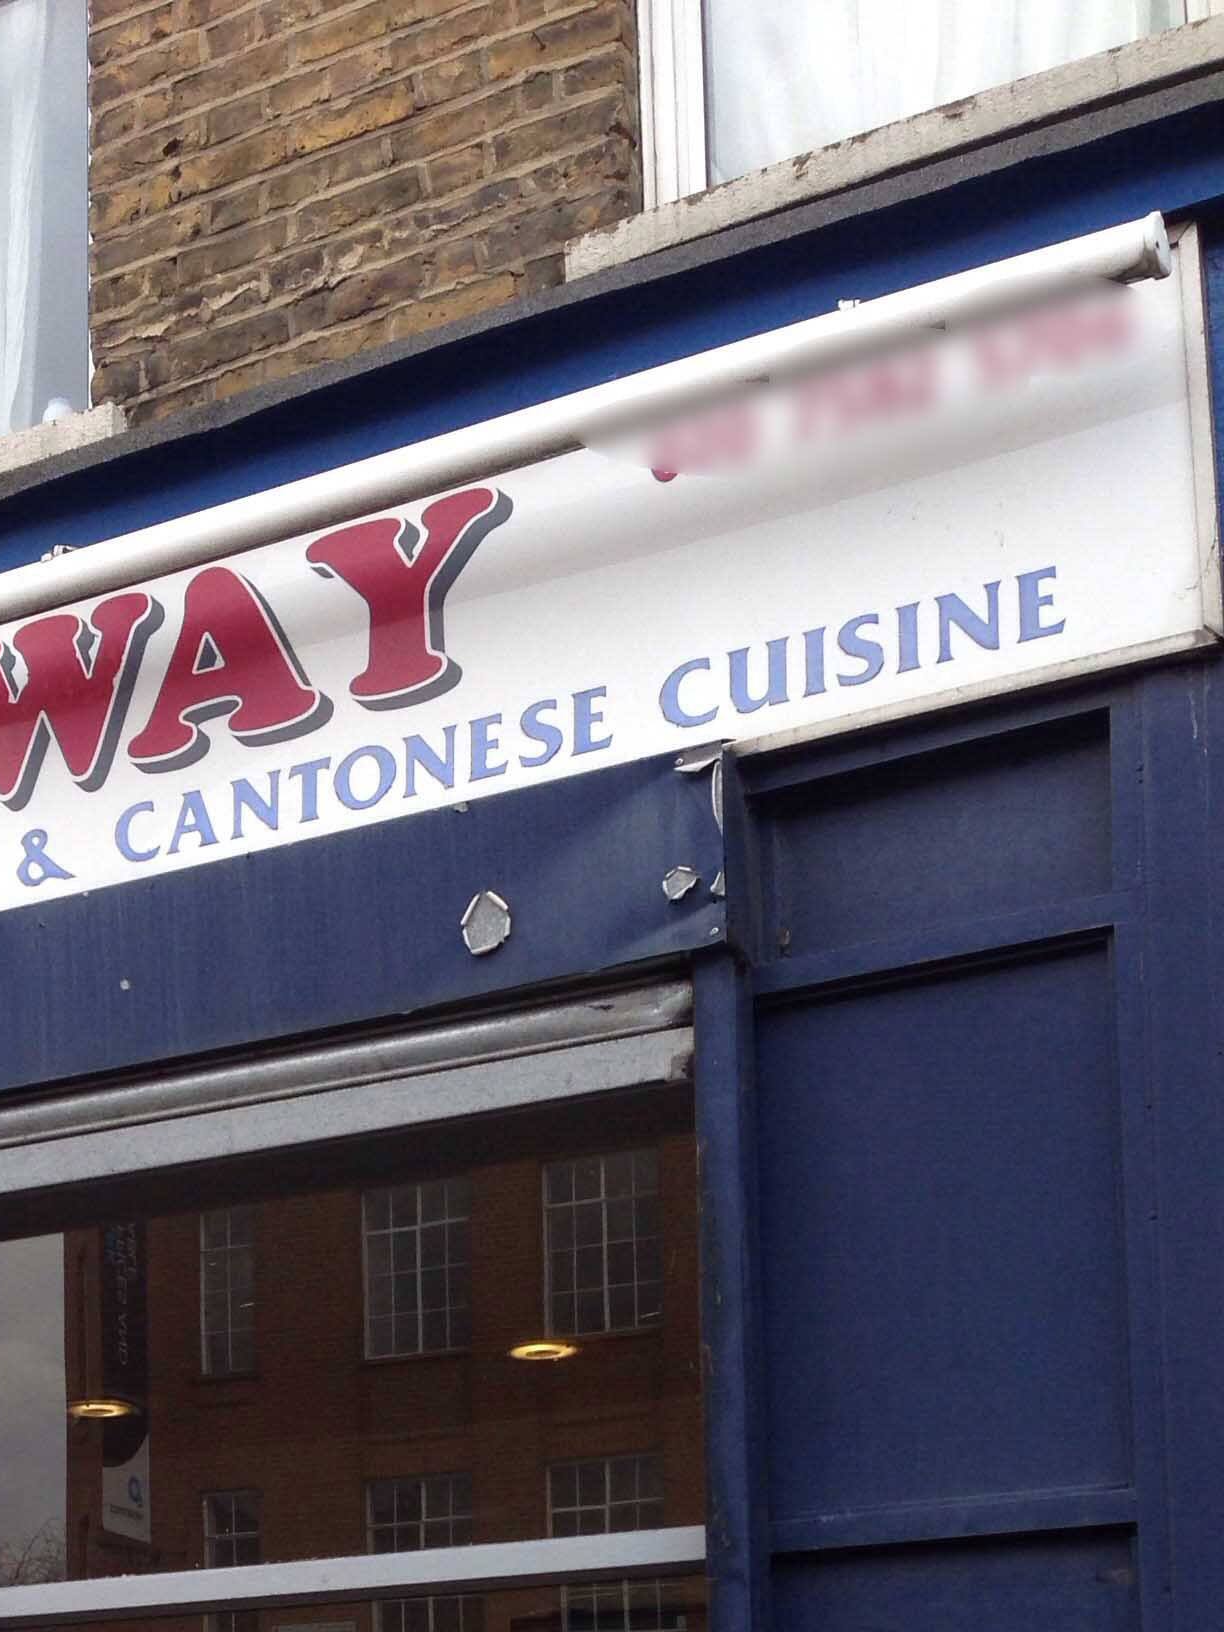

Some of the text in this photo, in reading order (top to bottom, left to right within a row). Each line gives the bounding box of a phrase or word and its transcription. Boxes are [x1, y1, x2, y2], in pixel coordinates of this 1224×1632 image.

[16, 828, 74, 886] &
[114, 685, 614, 862] CANTONESE
[658, 565, 1067, 729] CUISINE
